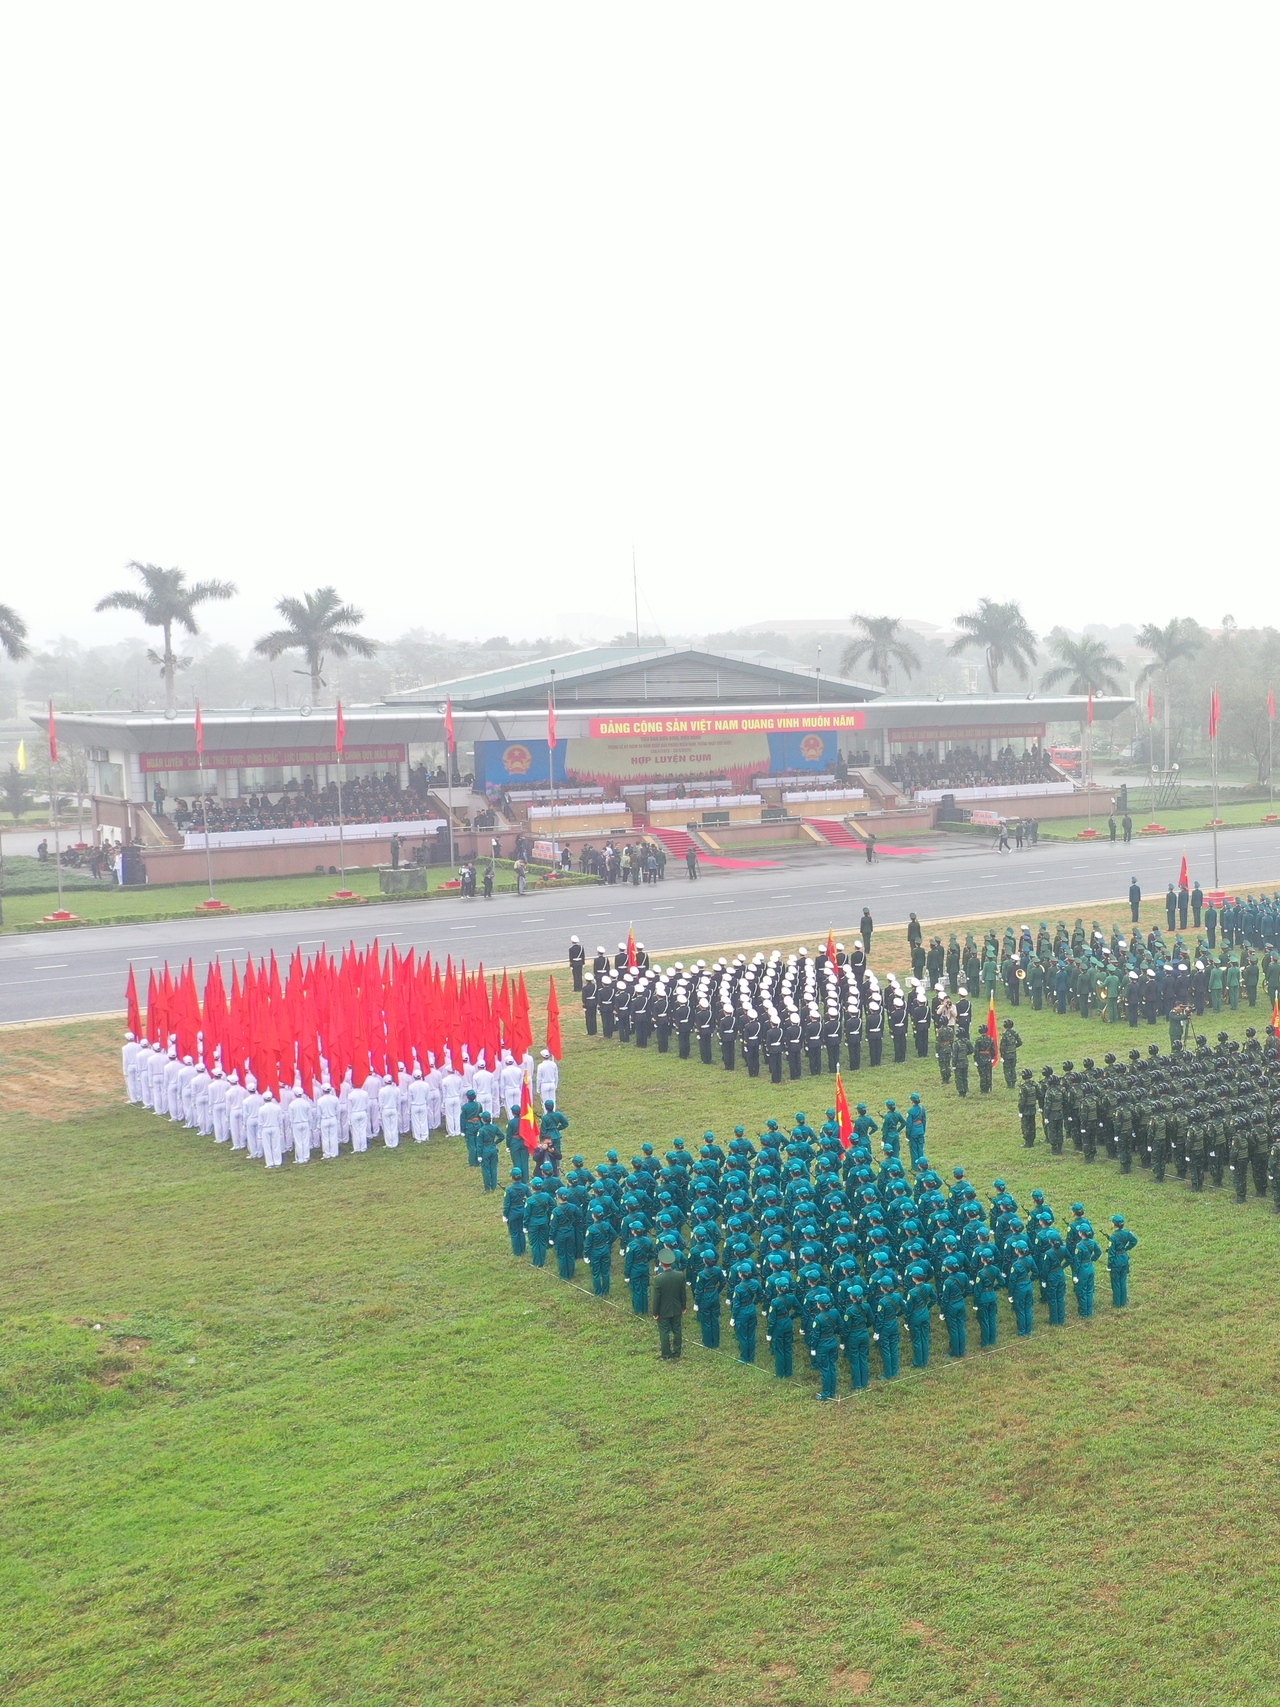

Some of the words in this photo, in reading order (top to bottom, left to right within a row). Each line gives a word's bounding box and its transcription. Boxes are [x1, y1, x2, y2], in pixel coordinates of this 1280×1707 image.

[600, 720, 630, 734] ĐẢNG
[633, 720, 663, 735] CỘNG
[666, 718, 688, 732] SẢN
[690, 718, 712, 733] VIỆT
[714, 720, 739, 731] NAM
[741, 718, 774, 730] QUANG
[776, 717, 799, 728] VINH
[802, 715, 830, 728] MUÔN
[832, 714, 855, 726] NĂM
[631, 756, 652, 766] HỢP
[655, 754, 686, 764] LUYỆN
[689, 754, 712, 763] CỤM
